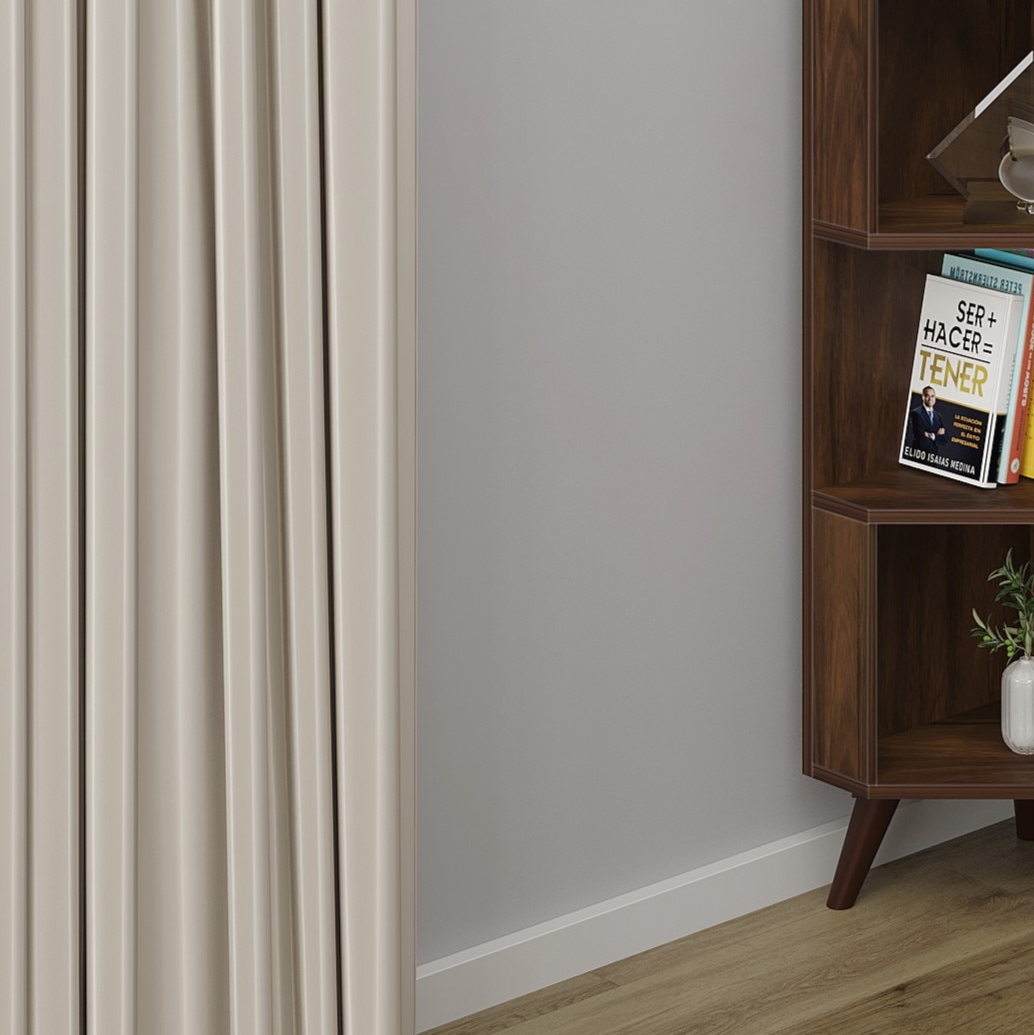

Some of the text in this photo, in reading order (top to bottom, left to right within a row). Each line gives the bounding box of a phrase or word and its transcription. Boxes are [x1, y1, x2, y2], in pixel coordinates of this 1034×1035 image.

[918, 349, 988, 397] TENER
[904, 446, 975, 475] ELIDO ISAIAS MEDINA
